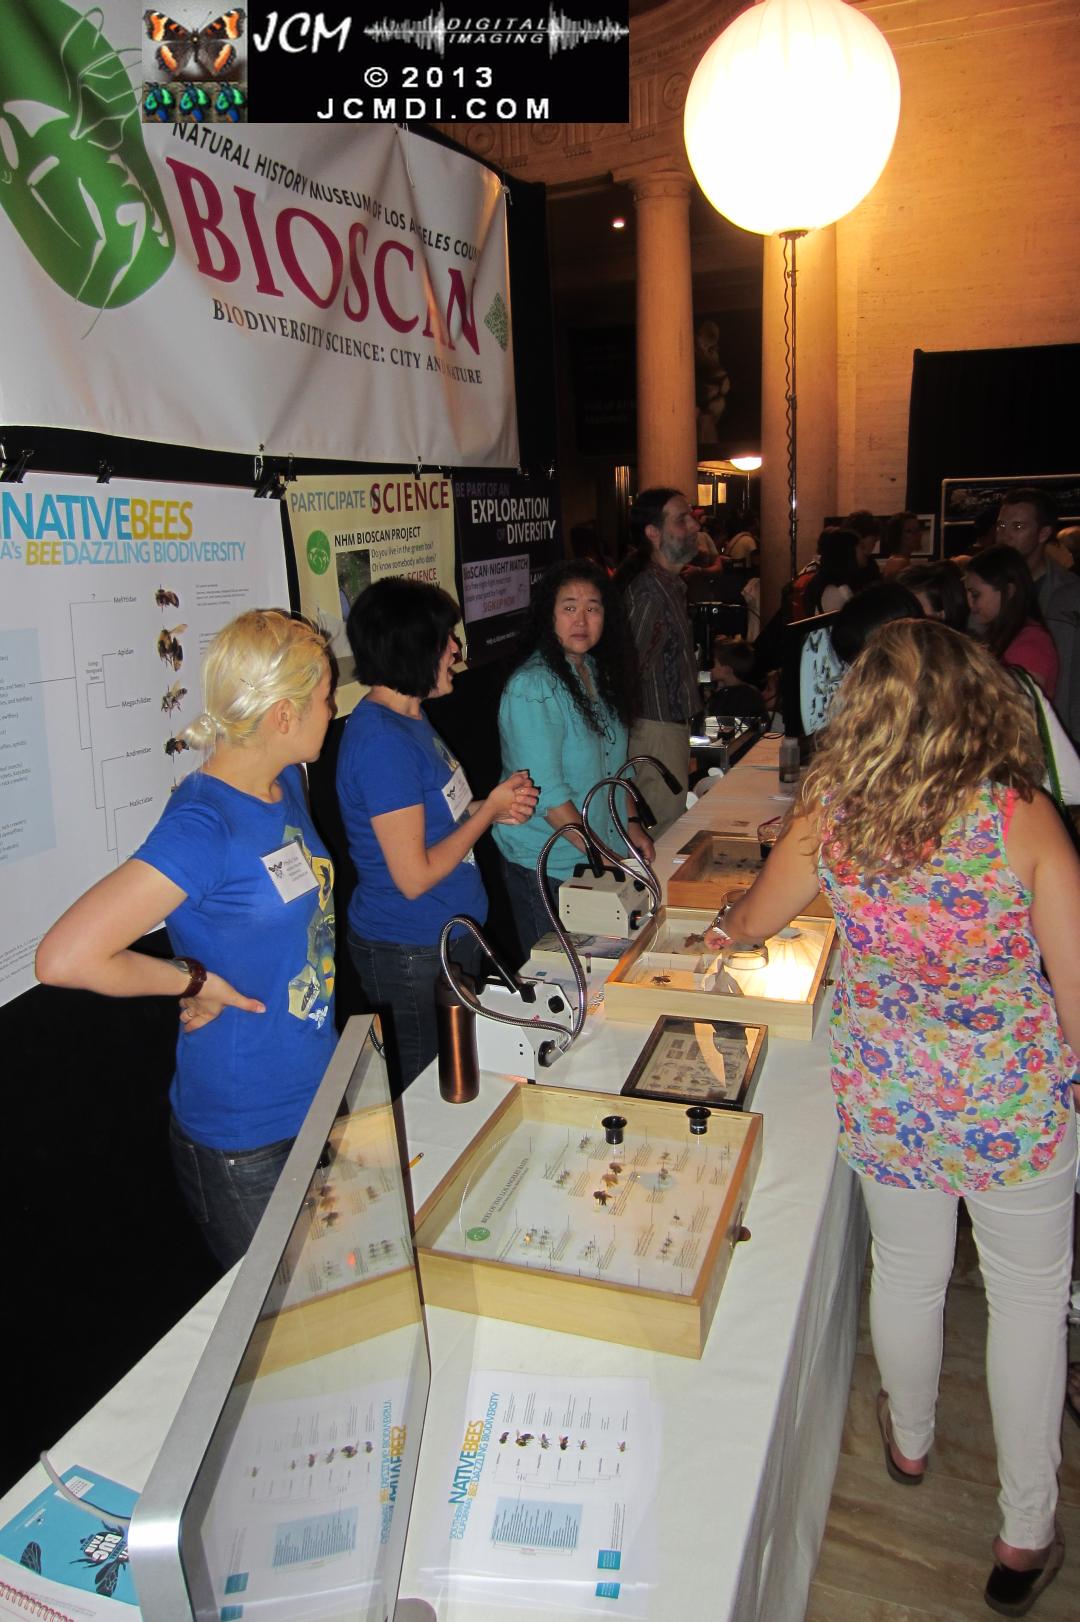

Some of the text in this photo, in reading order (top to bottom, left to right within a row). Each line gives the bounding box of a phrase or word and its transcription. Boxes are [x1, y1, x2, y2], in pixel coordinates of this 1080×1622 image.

[172, 122, 250, 169] NATURAL
[255, 153, 308, 195] HISTORY
[309, 181, 372, 213] MUSEUM
[373, 200, 382, 220] OF
[384, 207, 406, 230] LOS
[409, 218, 450, 252] AELES
[165, 156, 480, 355] BIOSCN
[213, 298, 325, 347] BIODIVERSITY
[326, 332, 385, 363] SCIENCE:
[390, 348, 421, 369] CITY
[290, 489, 366, 513] PARTICIPATE
[371, 481, 450, 514] SCIENCE
[471, 497, 549, 524] EXPLORATION
[334, 526, 421, 548] NHM BIOSCAN PROJECT
[507, 520, 556, 545] DIVERSITY
[154, 541, 246, 563] BIODIVERSITY
[490, 561, 509, 575] NIGHT
[480, 1392, 500, 1444] BIODIVERSITY
